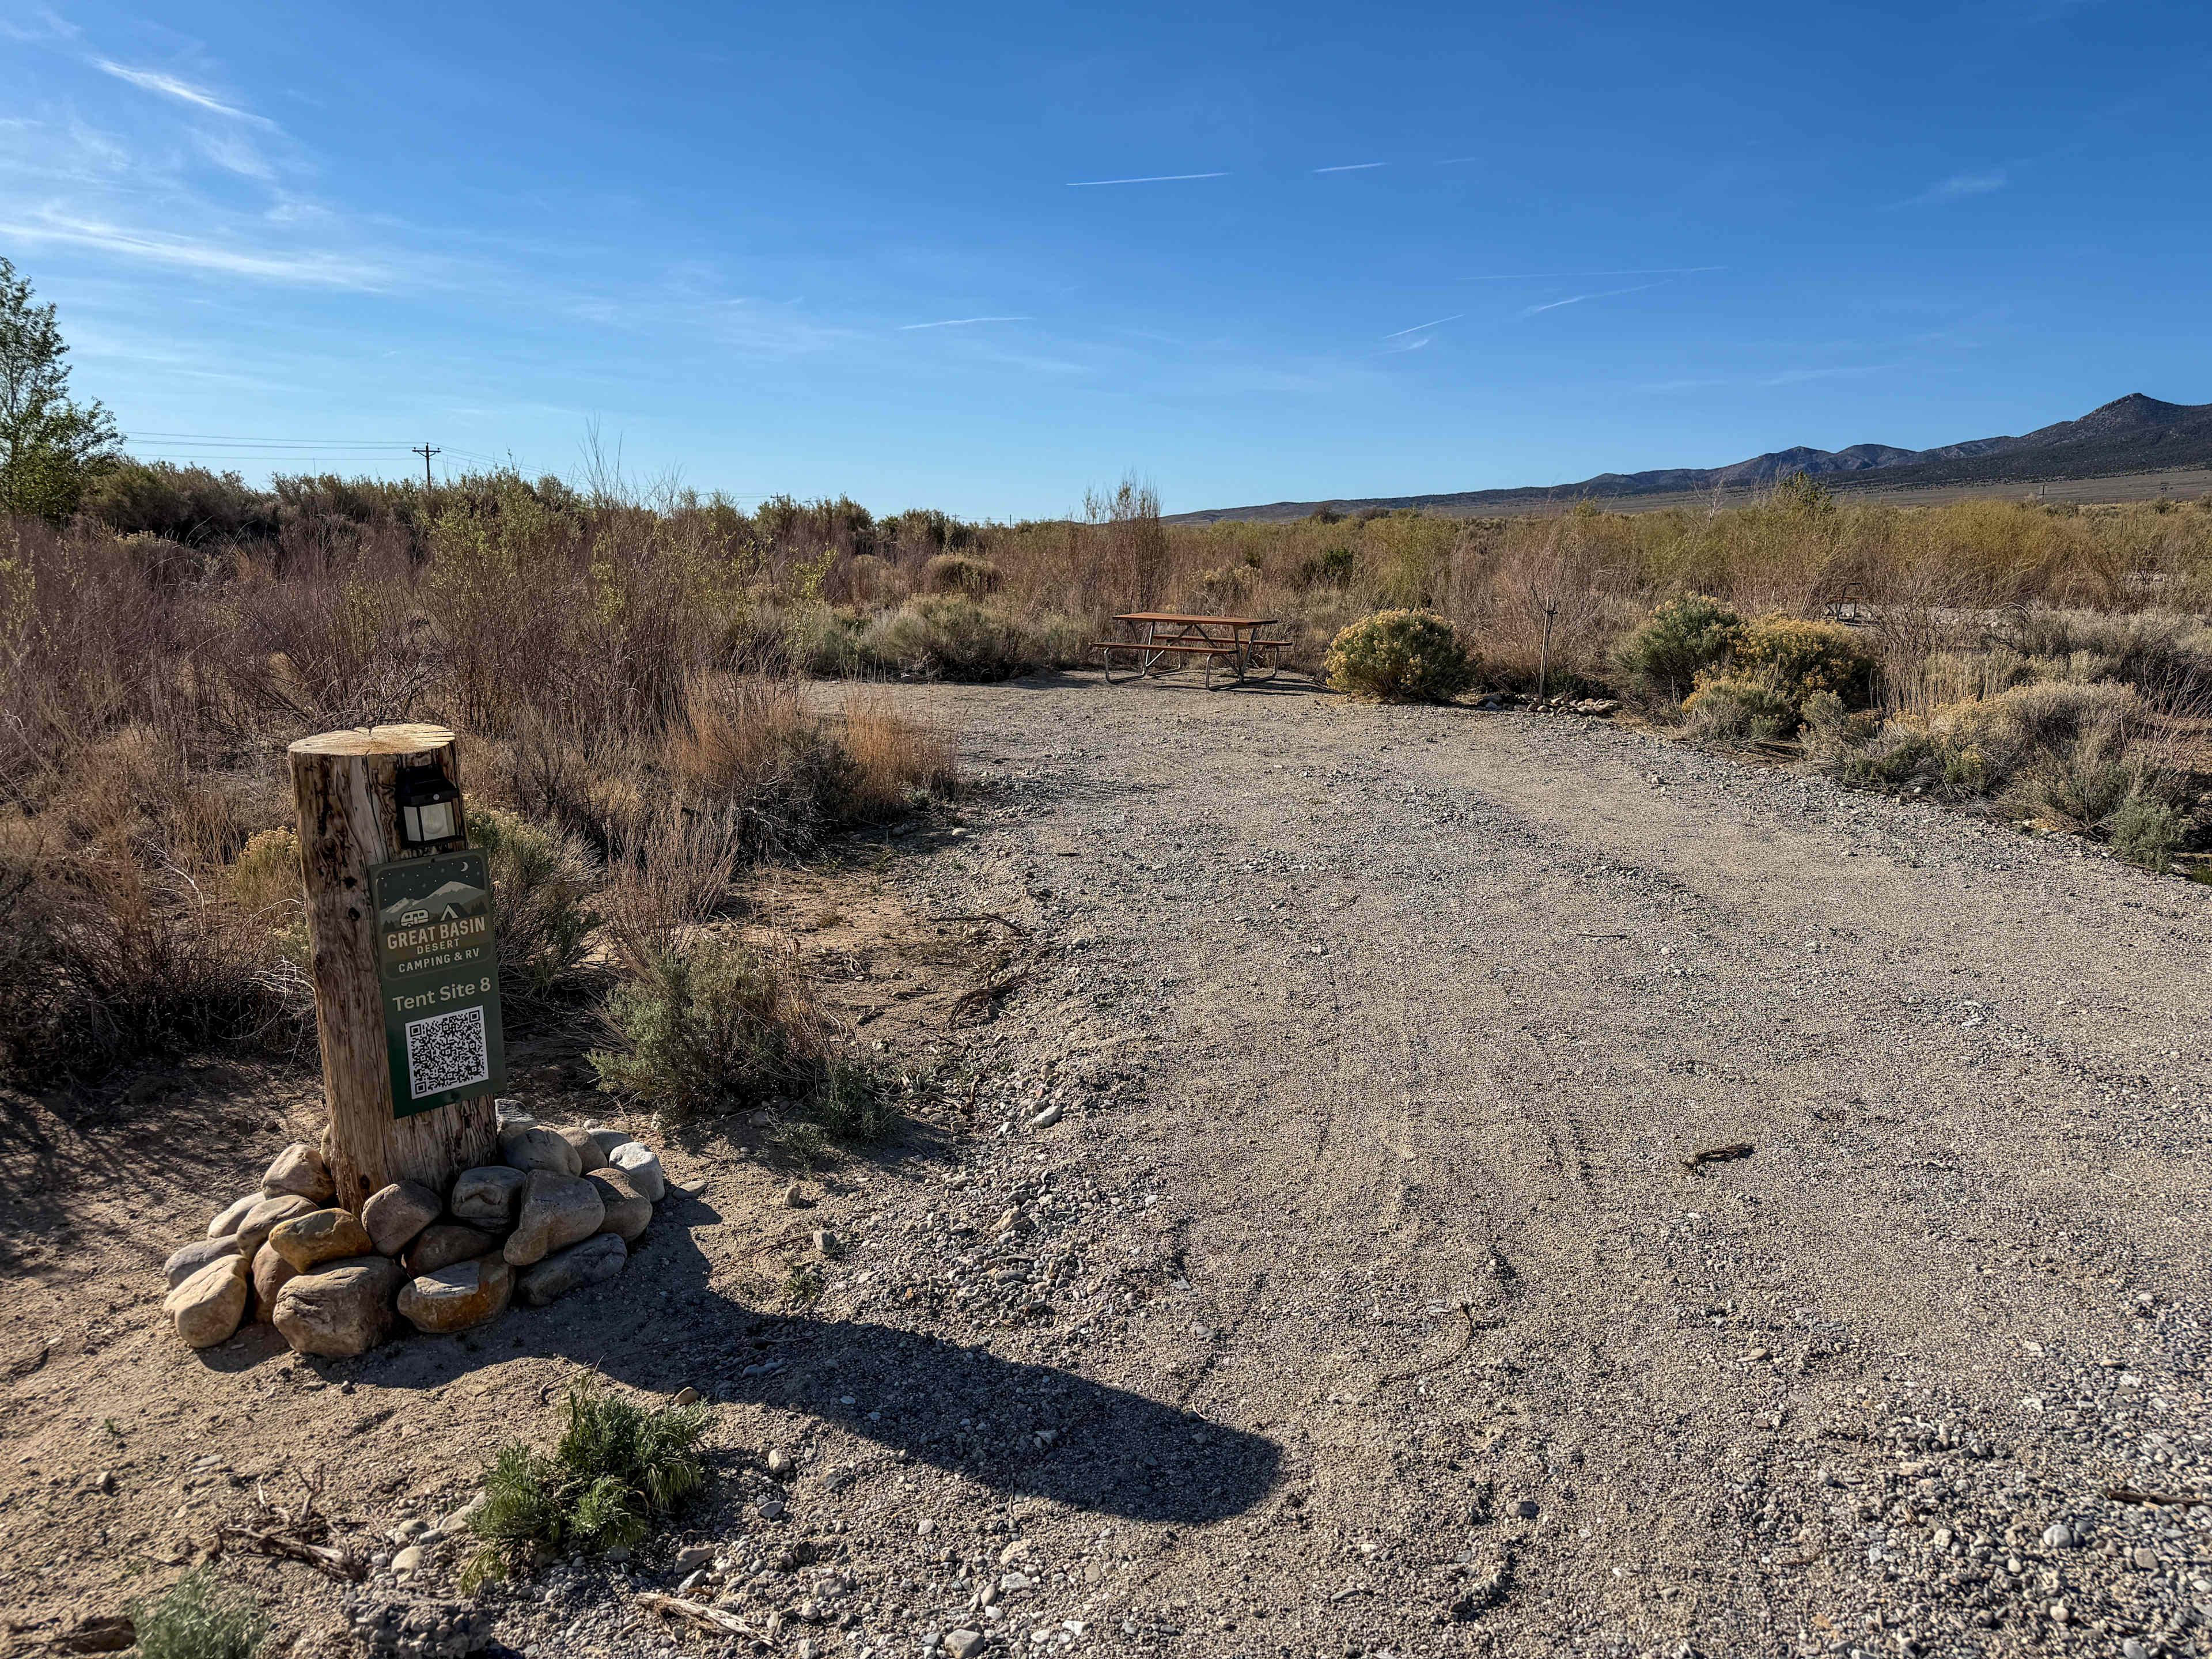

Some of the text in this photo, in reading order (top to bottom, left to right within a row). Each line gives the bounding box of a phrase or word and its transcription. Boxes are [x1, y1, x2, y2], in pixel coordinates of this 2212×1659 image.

[387, 916, 486, 949] GREAT BASIN
[417, 938, 460, 955] DESERT
[399, 948, 480, 973] CAMPING & RV
[392, 977, 491, 1011] Tent Site 8
